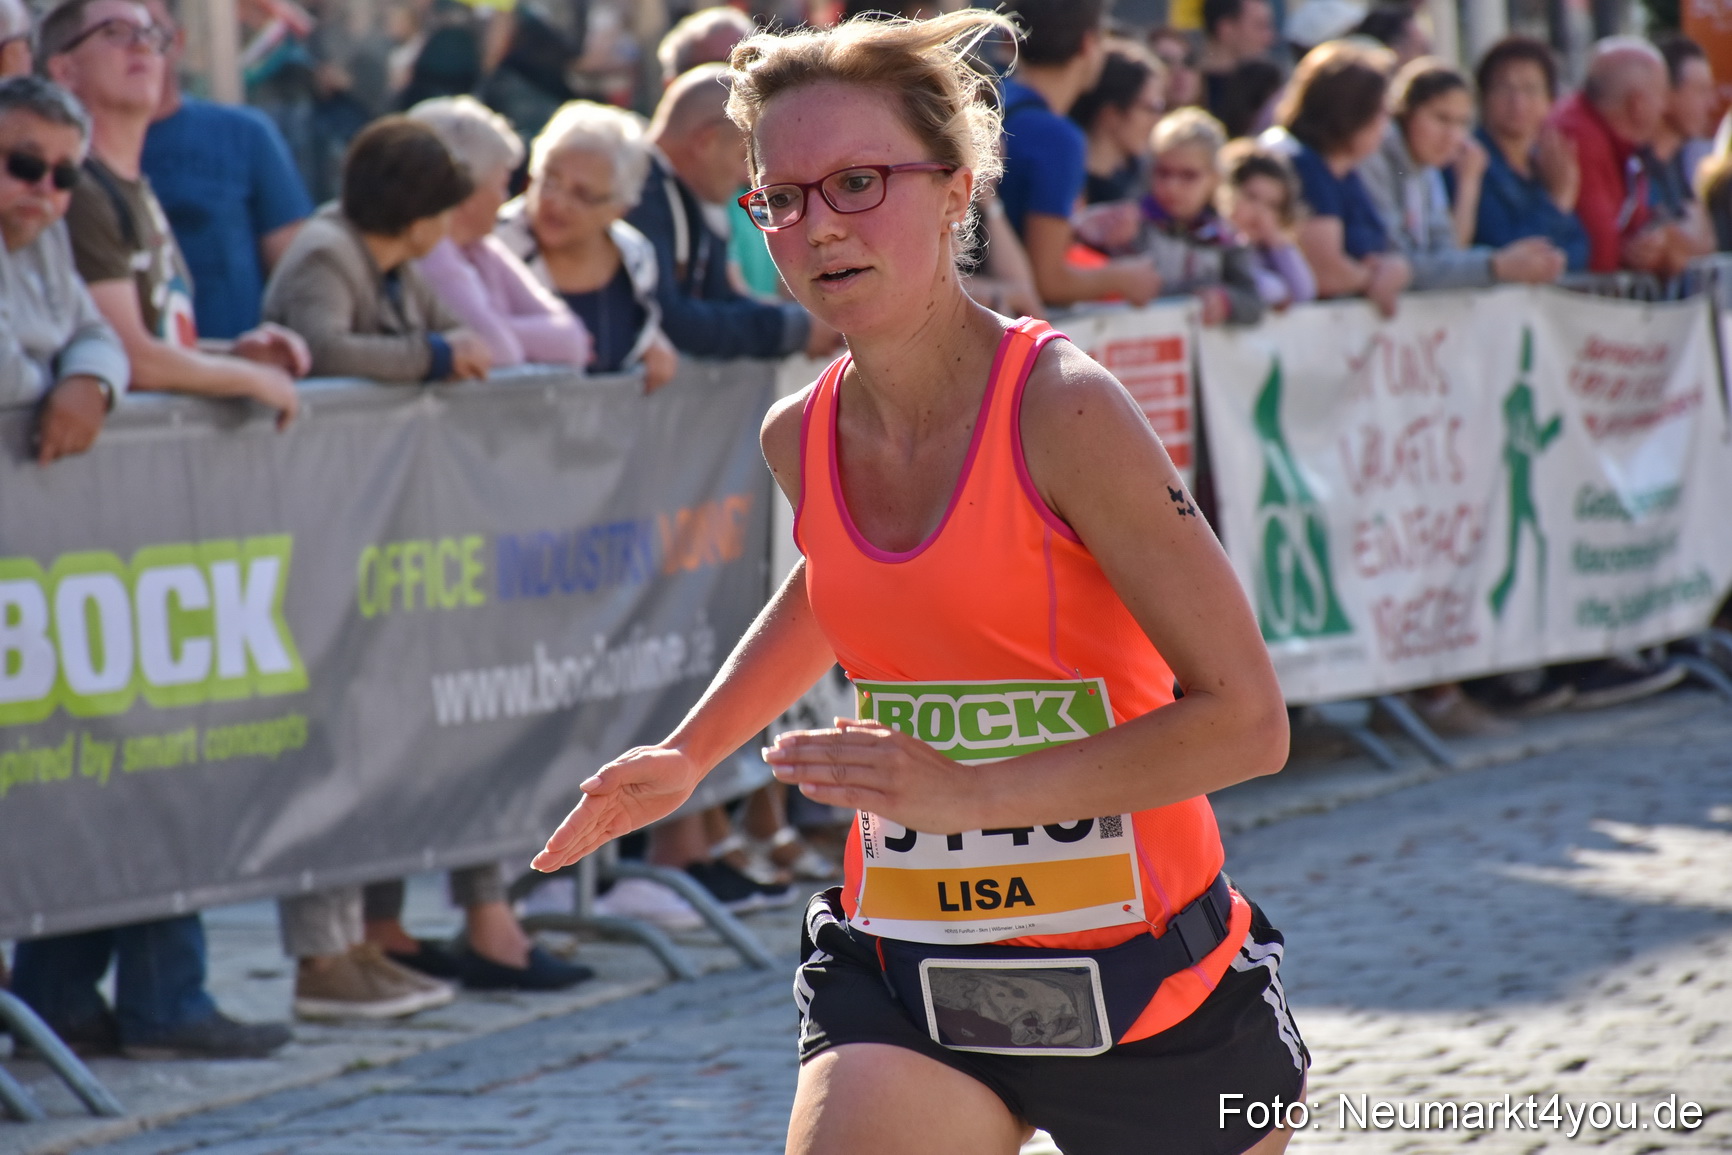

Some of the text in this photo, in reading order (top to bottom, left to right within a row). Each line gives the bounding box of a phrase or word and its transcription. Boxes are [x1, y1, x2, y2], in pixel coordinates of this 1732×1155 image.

[357, 534, 486, 619] OFFICE
[0, 556, 294, 701] BOCK
[876, 692, 1077, 745] BOCK
[80, 731, 116, 788] by
[937, 876, 1036, 912] LISA
